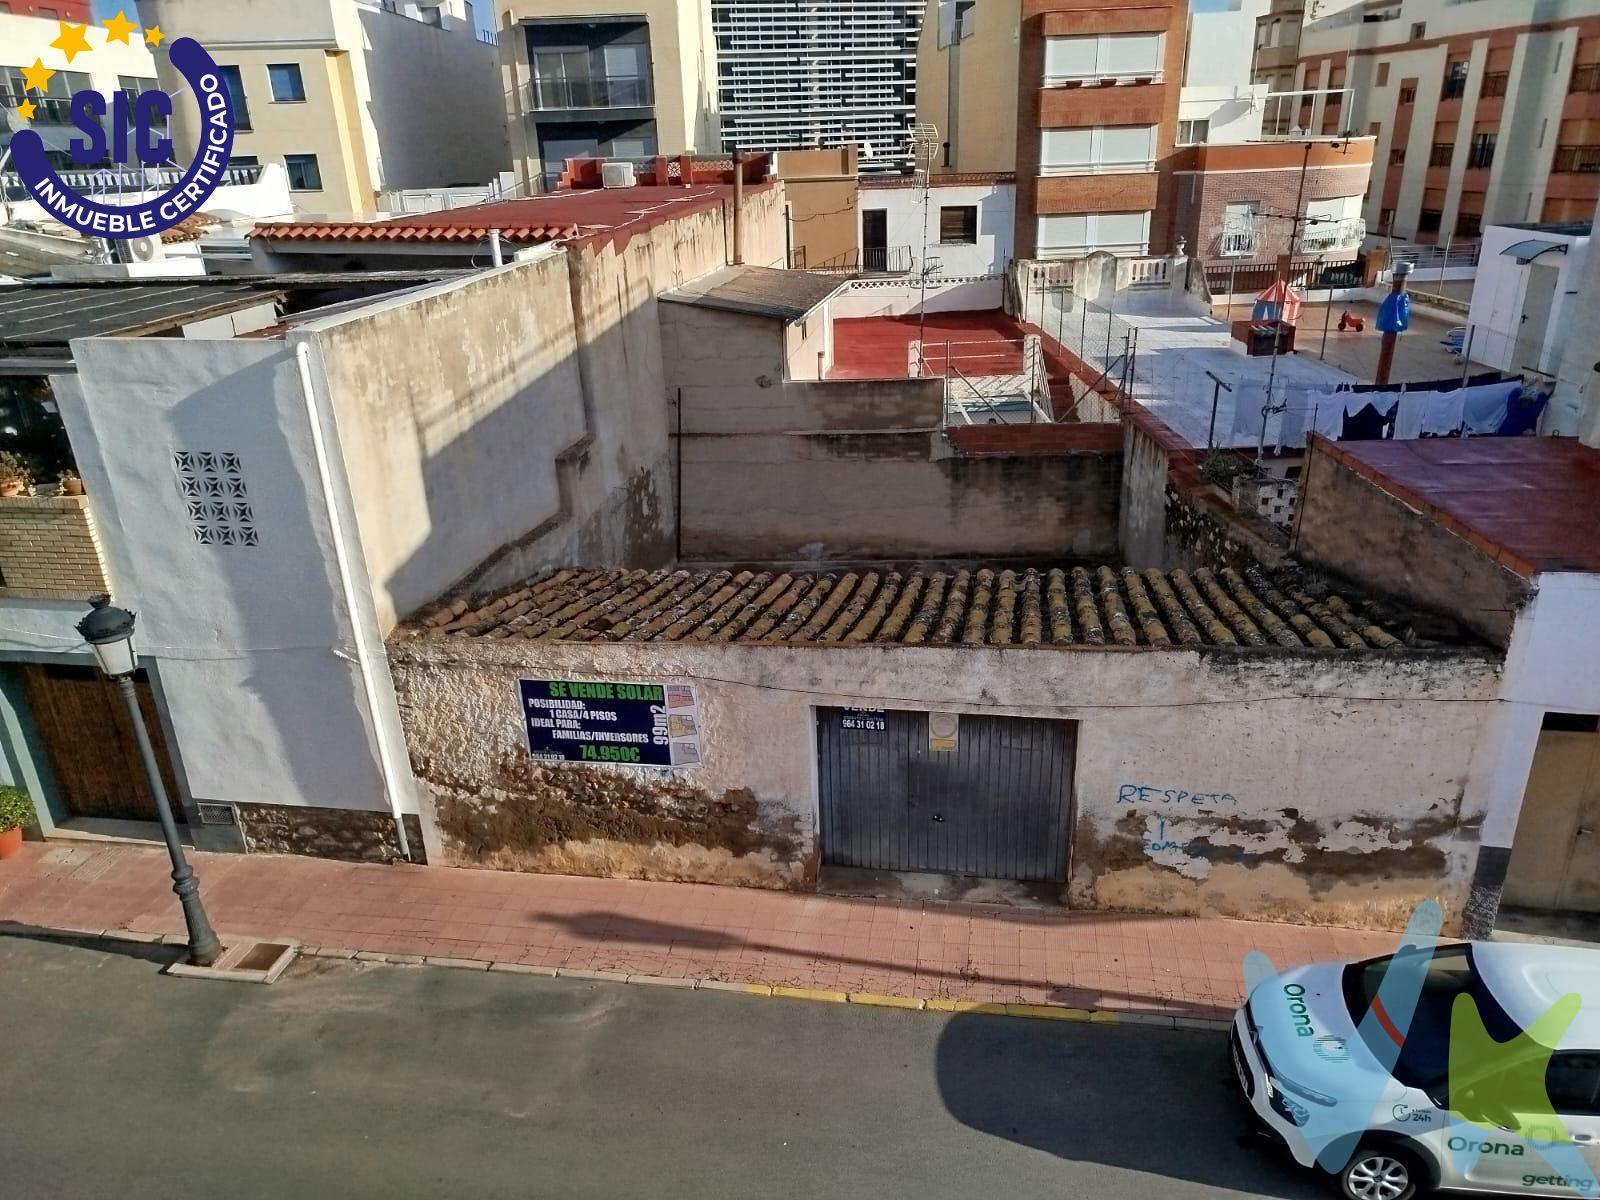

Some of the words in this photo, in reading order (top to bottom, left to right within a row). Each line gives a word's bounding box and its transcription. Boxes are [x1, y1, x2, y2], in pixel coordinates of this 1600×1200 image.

[550, 683, 568, 697] SE
[570, 683, 614, 699] VENDE
[616, 685, 664, 700] SOLAR
[528, 698, 586, 710] POSIBILIDAD:
[531, 717, 555, 728] IDEAL
[556, 718, 582, 729] PARA:
[555, 710, 589, 719] CASA/4
[590, 711, 618, 721] PISOS
[651, 705, 668, 745] 99m2
[856, 720, 865, 729] 31
[866, 720, 875, 729] 02
[876, 721, 885, 730] 18
[552, 730, 649, 744] FAMILIAS/INVERSORES
[580, 745, 640, 761] 74.950€
[1116, 784, 1238, 805] RESPETA
[1283, 983, 1315, 1037] Orona
[1412, 1113, 1432, 1122] 24h
[1447, 1136, 1525, 1156] Orona
[1522, 1174, 1593, 1191] getting
